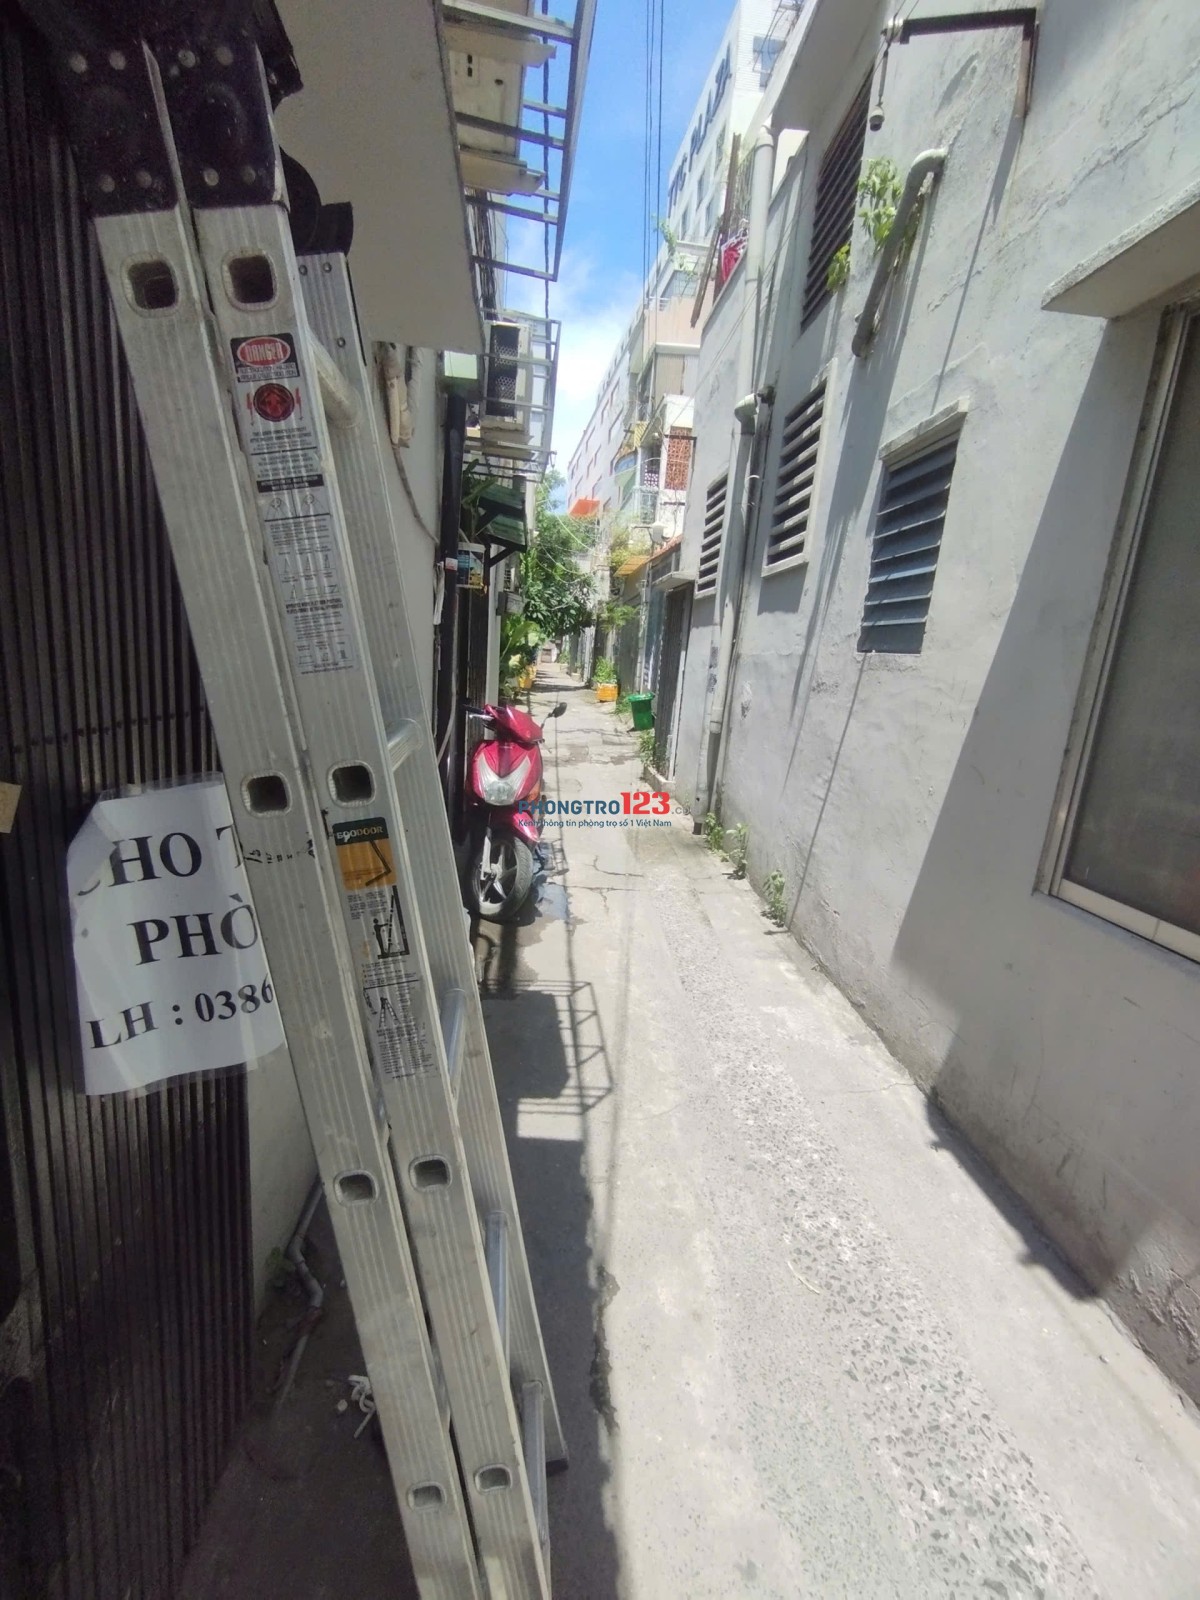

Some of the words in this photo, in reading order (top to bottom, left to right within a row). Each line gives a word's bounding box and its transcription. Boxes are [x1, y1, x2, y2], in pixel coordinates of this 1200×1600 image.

[688, 40, 732, 173] PLAZA
[245, 342, 285, 362] DANGER
[78, 831, 202, 896] HO
[86, 1000, 159, 1050] LH
